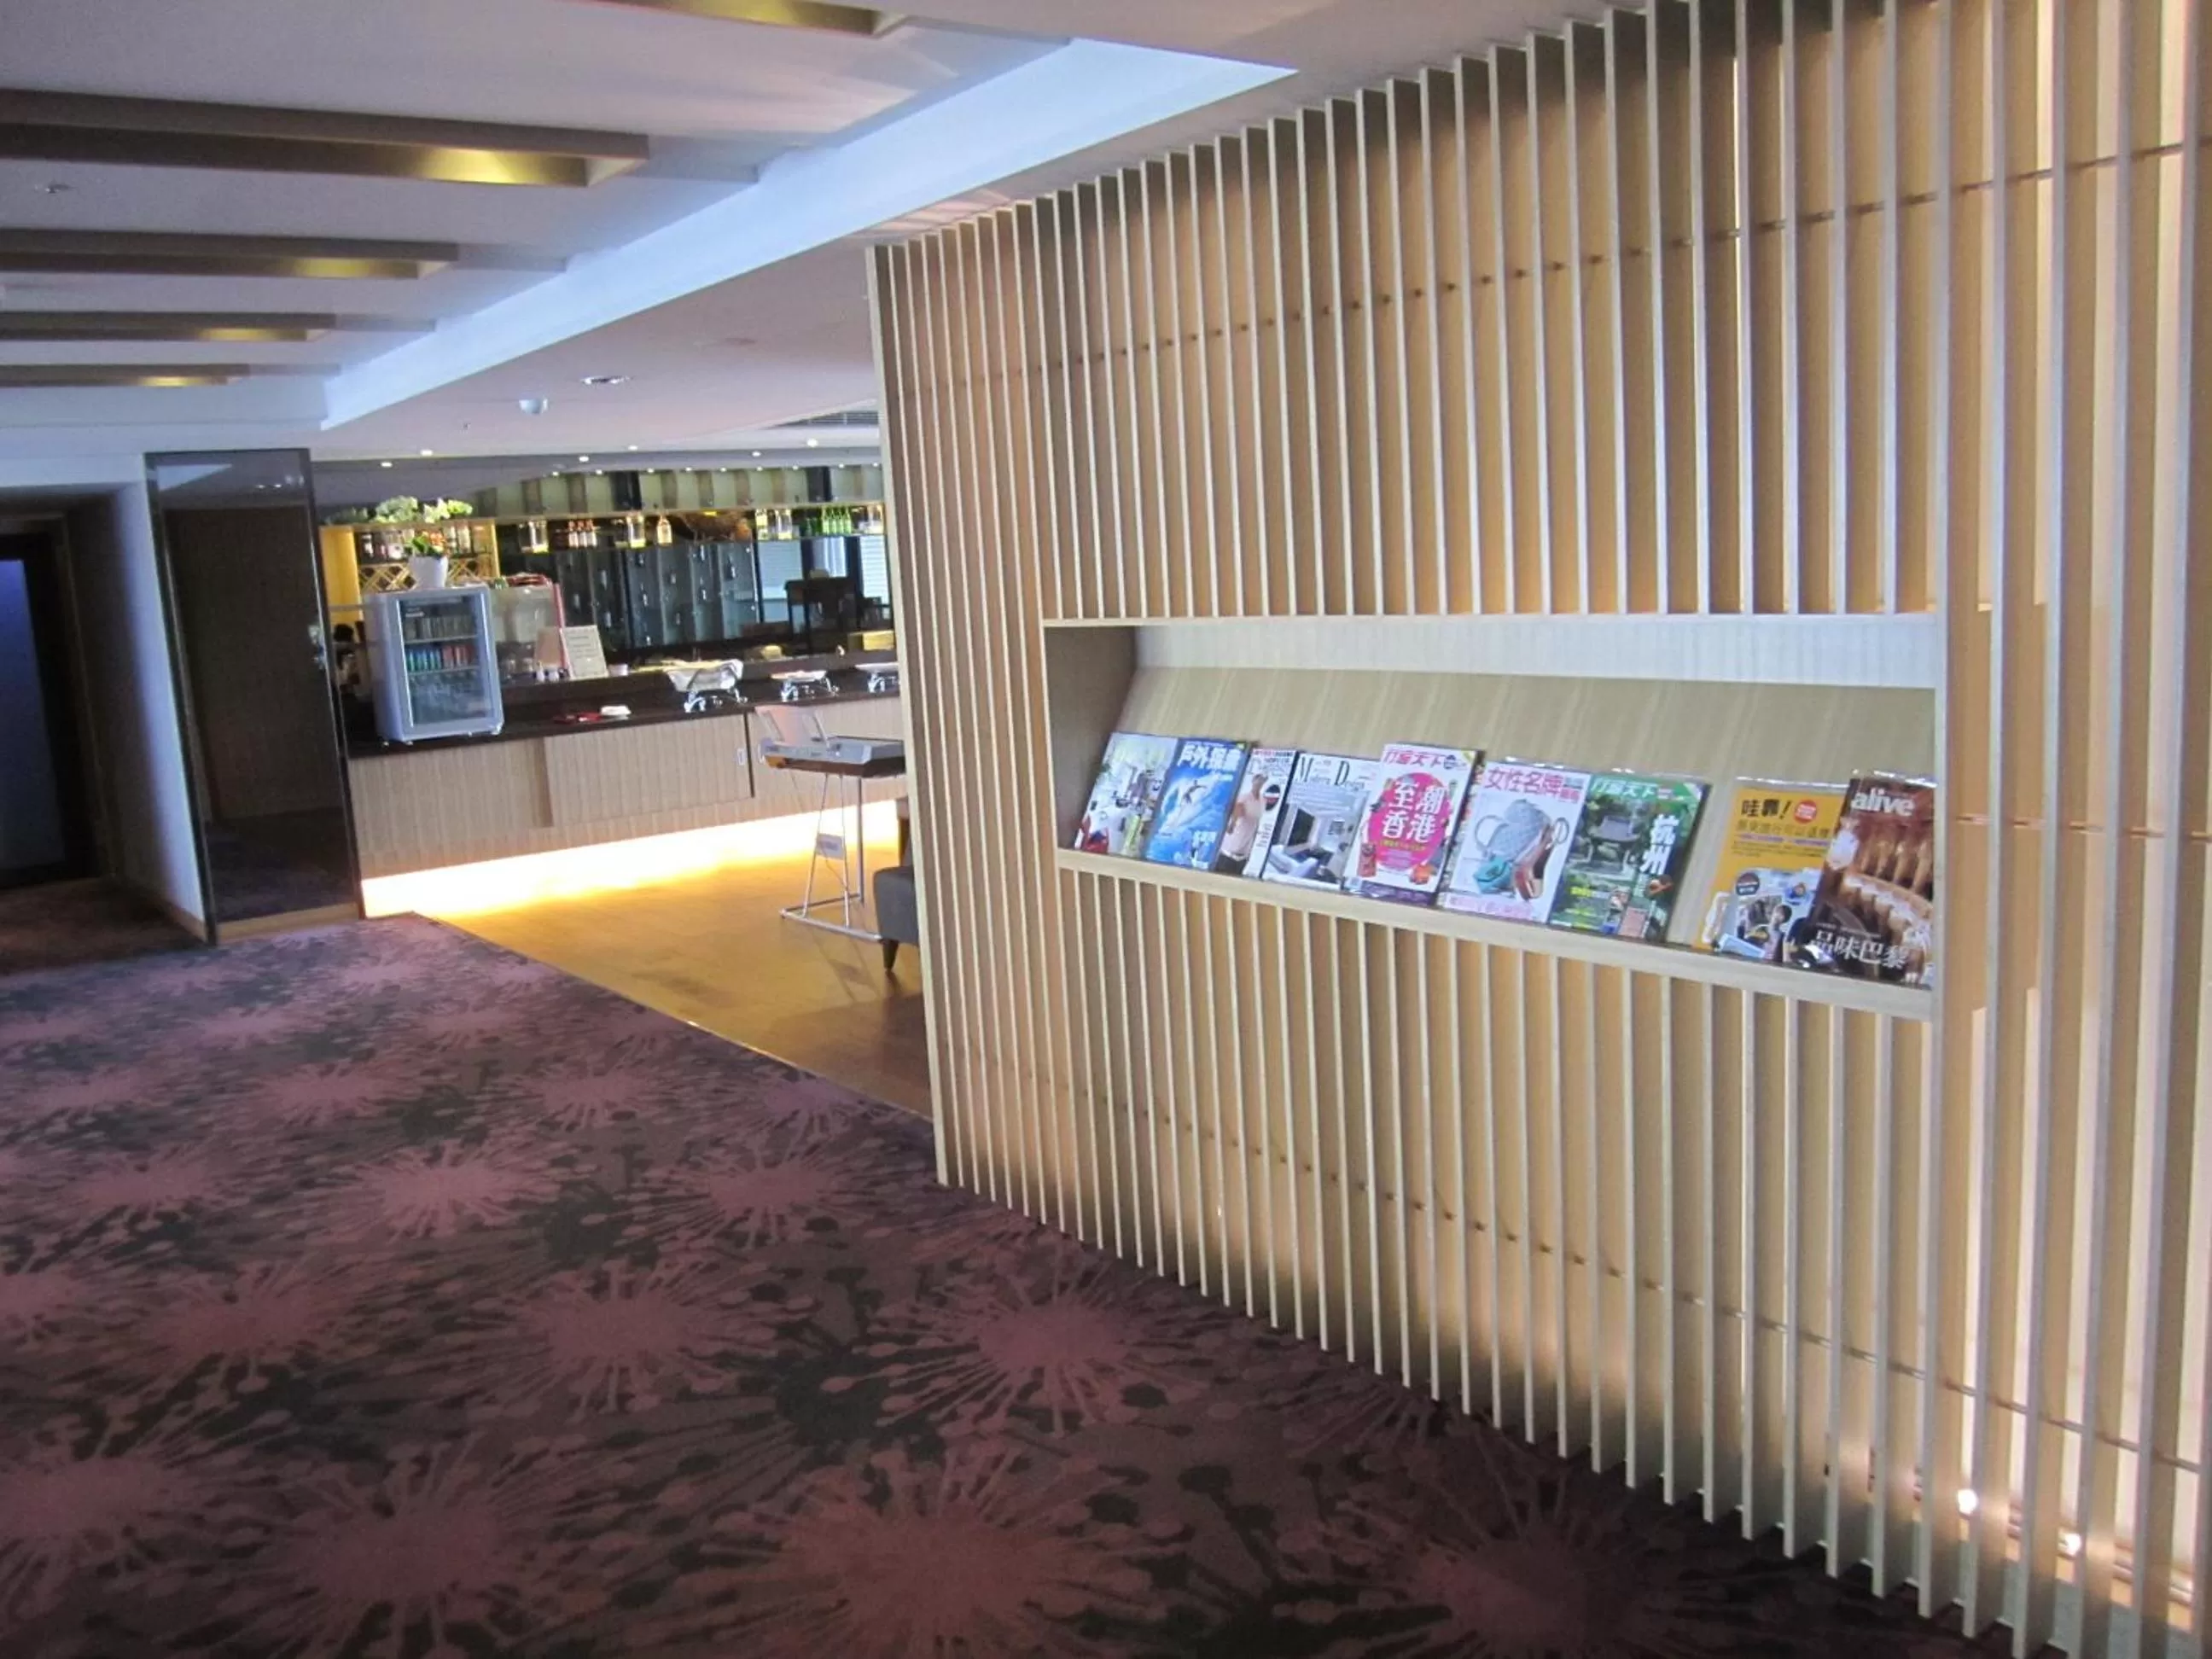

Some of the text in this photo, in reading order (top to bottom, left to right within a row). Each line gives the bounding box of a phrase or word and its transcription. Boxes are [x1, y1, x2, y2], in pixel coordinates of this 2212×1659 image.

[1850, 788, 1916, 817] alive
[1382, 810, 1436, 843] 香港
[1639, 813, 1679, 876] 杭州
[1808, 929, 1909, 969] 品味巴黎
